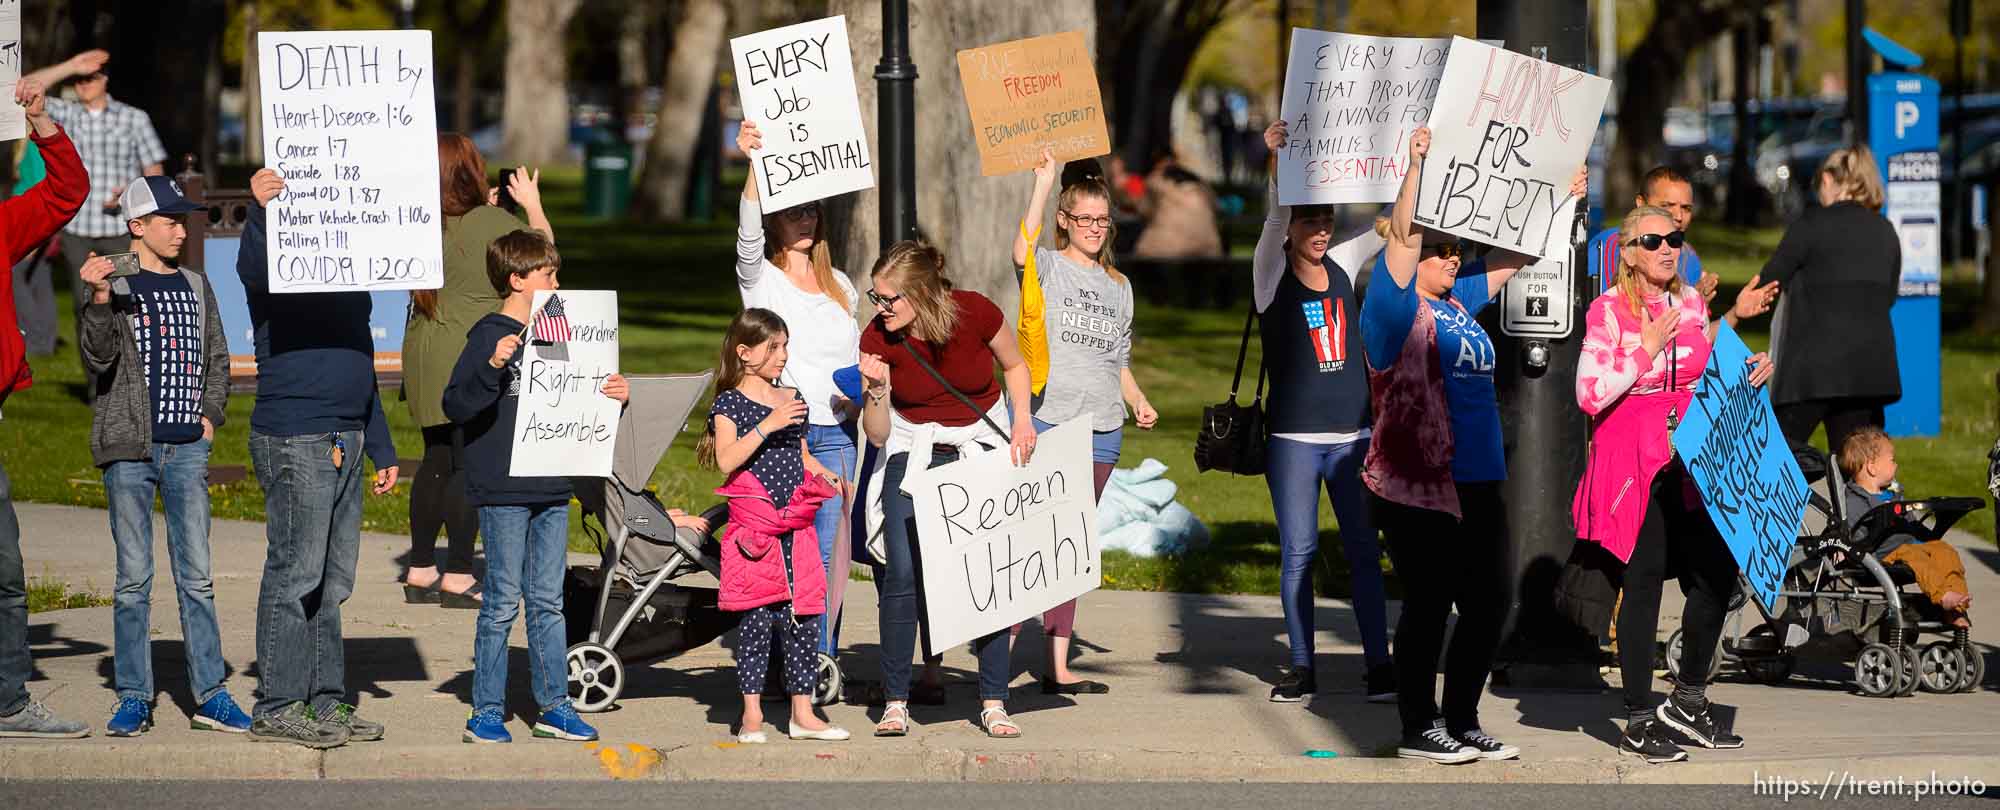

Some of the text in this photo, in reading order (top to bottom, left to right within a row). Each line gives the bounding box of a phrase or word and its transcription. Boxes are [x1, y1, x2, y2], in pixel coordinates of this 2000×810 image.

[276, 43, 422, 98] DEATH by
[745, 33, 830, 86] EVERY
[1314, 43, 1395, 71] EVERY
[1003, 72, 1062, 101] FREEDOM
[1304, 80, 1357, 105] THAT
[1467, 47, 1584, 143] HONK
[273, 103, 413, 130] Heart Disease 1:6
[765, 86, 811, 121] Job
[1294, 113, 1309, 135] A
[1323, 104, 1392, 129] LIVING
[788, 122, 809, 142] is
[984, 115, 1040, 148] ECONOMIC
[1042, 107, 1096, 133] SECURITY
[1894, 101, 1920, 139] P
[275, 136, 319, 159] Cancer
[1289, 135, 1377, 161] FAMILIES
[1474, 119, 1532, 173] FOR
[278, 162, 322, 180] Suicide
[762, 139, 870, 197] ESSENTIAL
[1304, 155, 1407, 187] ESSENTIAL
[278, 207, 315, 227] Motor
[319, 209, 360, 226] Vehicle
[361, 210, 390, 225] Crash
[278, 231, 321, 252] Falling
[278, 254, 355, 284] COVID19
[1533, 272, 1558, 280] BUTTON
[1079, 288, 1100, 300] MY
[1527, 283, 1548, 294] FOR
[1061, 311, 1121, 337] NEEDS
[1061, 330, 1114, 351] COFFEE
[529, 360, 586, 408] Right
[1695, 350, 1732, 425] MY
[522, 412, 611, 445] Assemble
[1689, 356, 1762, 508] CONSTITUTION
[1713, 400, 1770, 536] RIGHTS
[938, 470, 1066, 545] Reopen
[1744, 465, 1772, 535] ARE
[1746, 461, 1814, 614] ESSENTIAL
[964, 511, 1092, 612] Utah!
